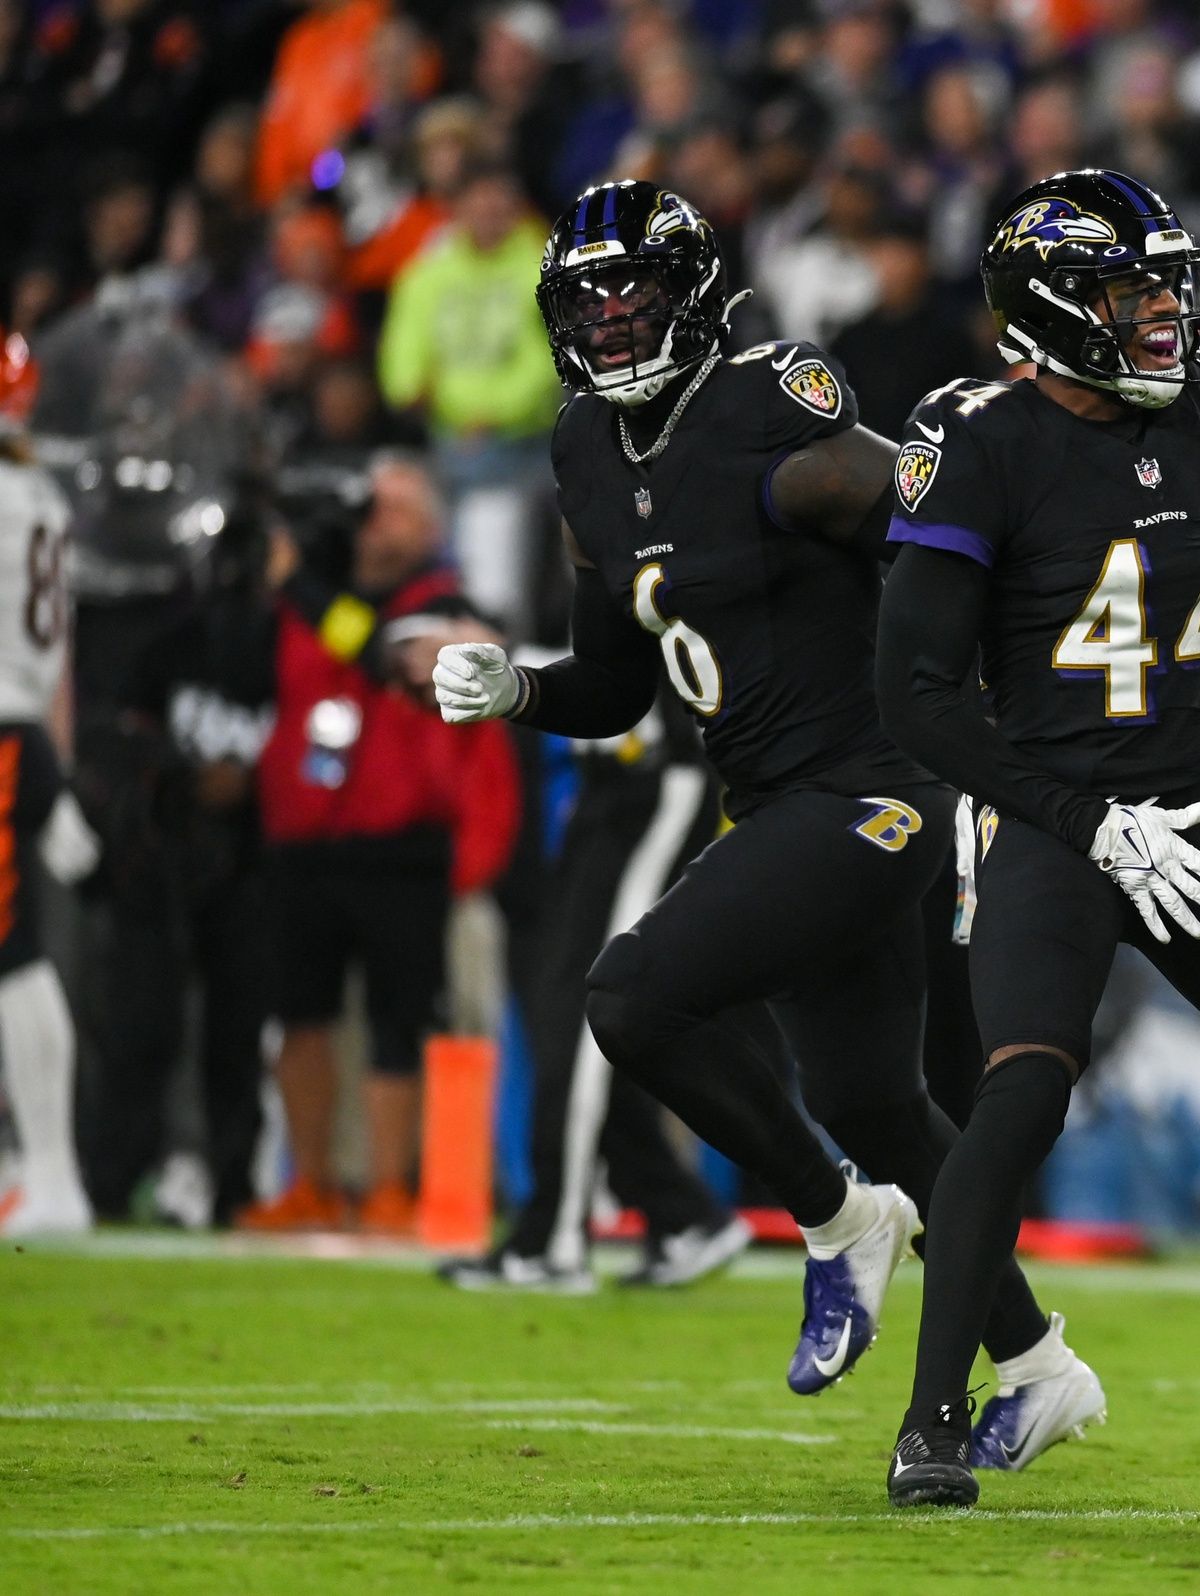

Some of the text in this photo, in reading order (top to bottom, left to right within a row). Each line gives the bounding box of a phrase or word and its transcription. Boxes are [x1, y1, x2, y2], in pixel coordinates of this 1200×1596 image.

[576, 242, 609, 256] RAVENS
[785, 363, 822, 384] RAVENS
[903, 446, 935, 460] RAVENS
[1133, 511, 1188, 528] RAVENS
[634, 543, 674, 560] RAVENS
[632, 562, 723, 716] 6
[848, 797, 923, 851] B
